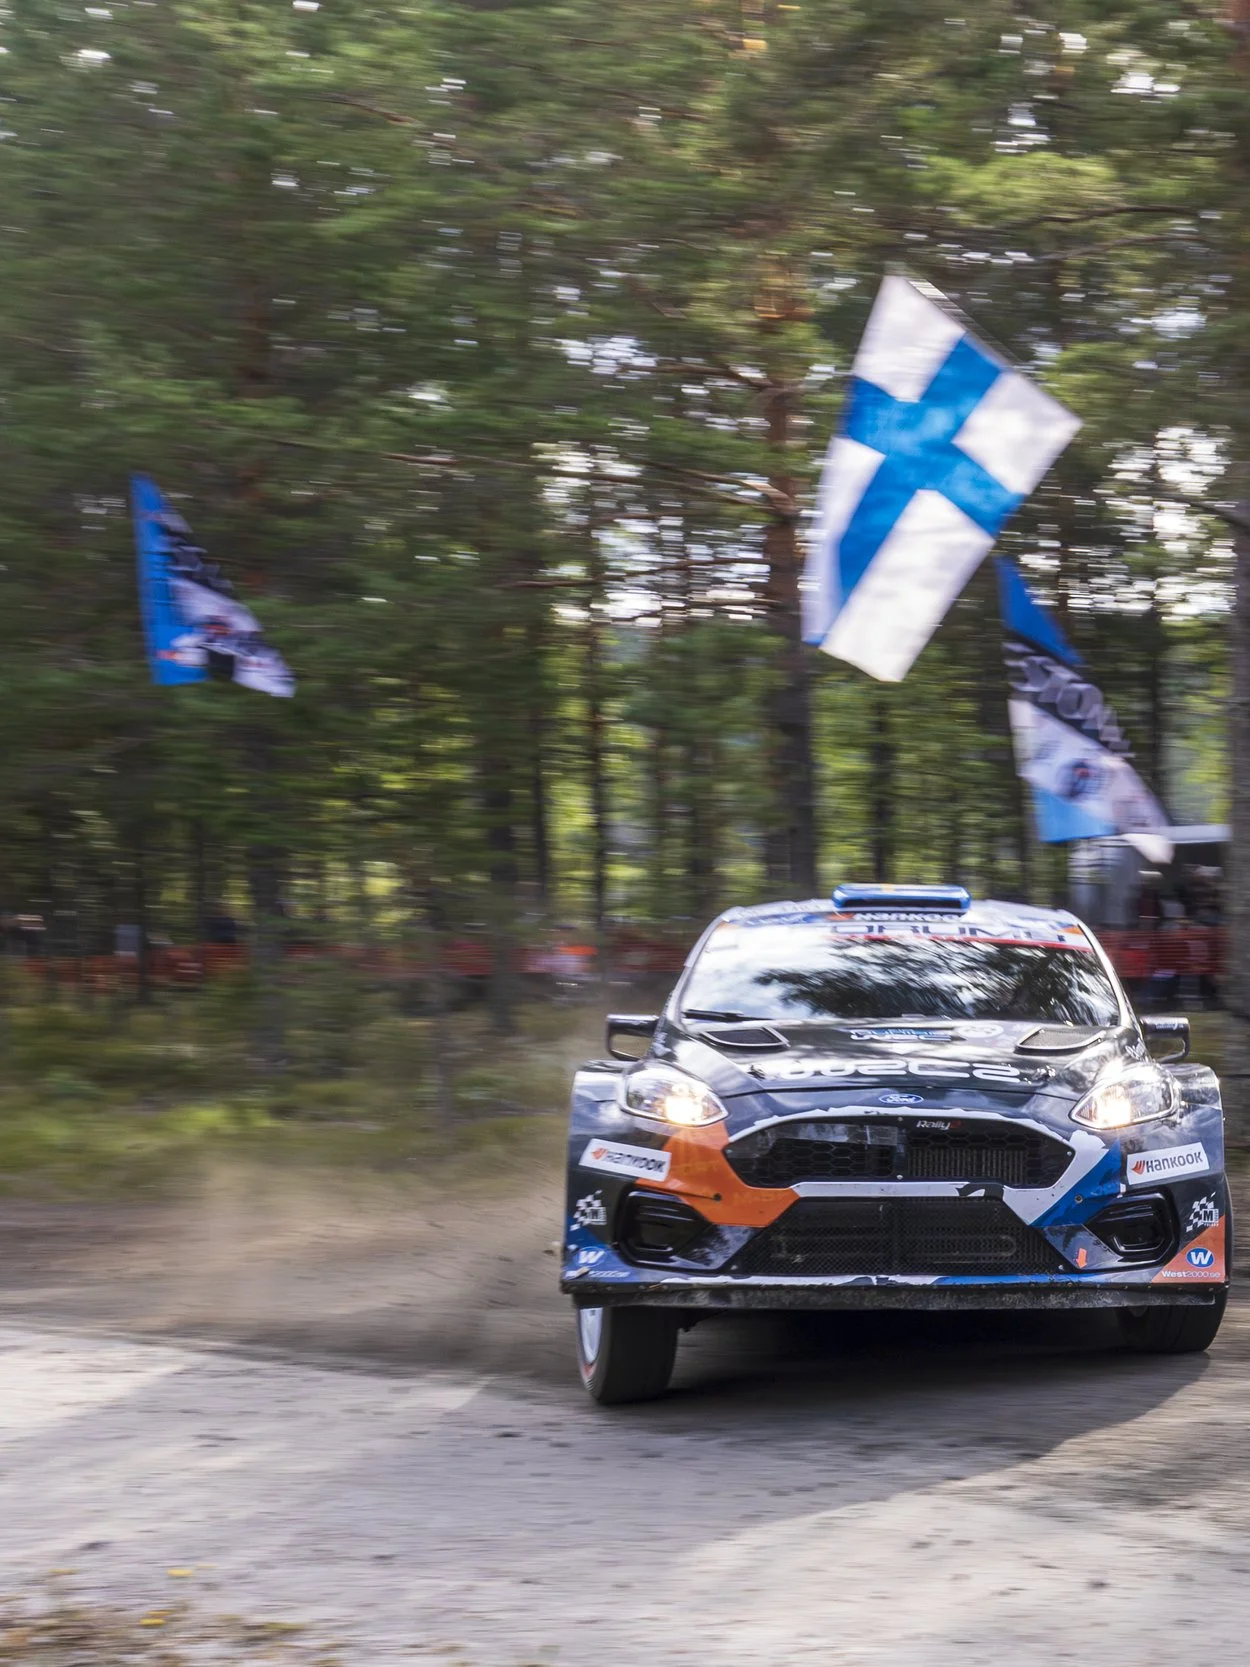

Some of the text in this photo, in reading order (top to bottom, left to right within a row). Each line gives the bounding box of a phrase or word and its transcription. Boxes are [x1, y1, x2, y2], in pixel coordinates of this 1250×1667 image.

[916, 1119, 963, 1130] Rally2
[578, 1250, 605, 1264] W
[1190, 1250, 1212, 1265] W
